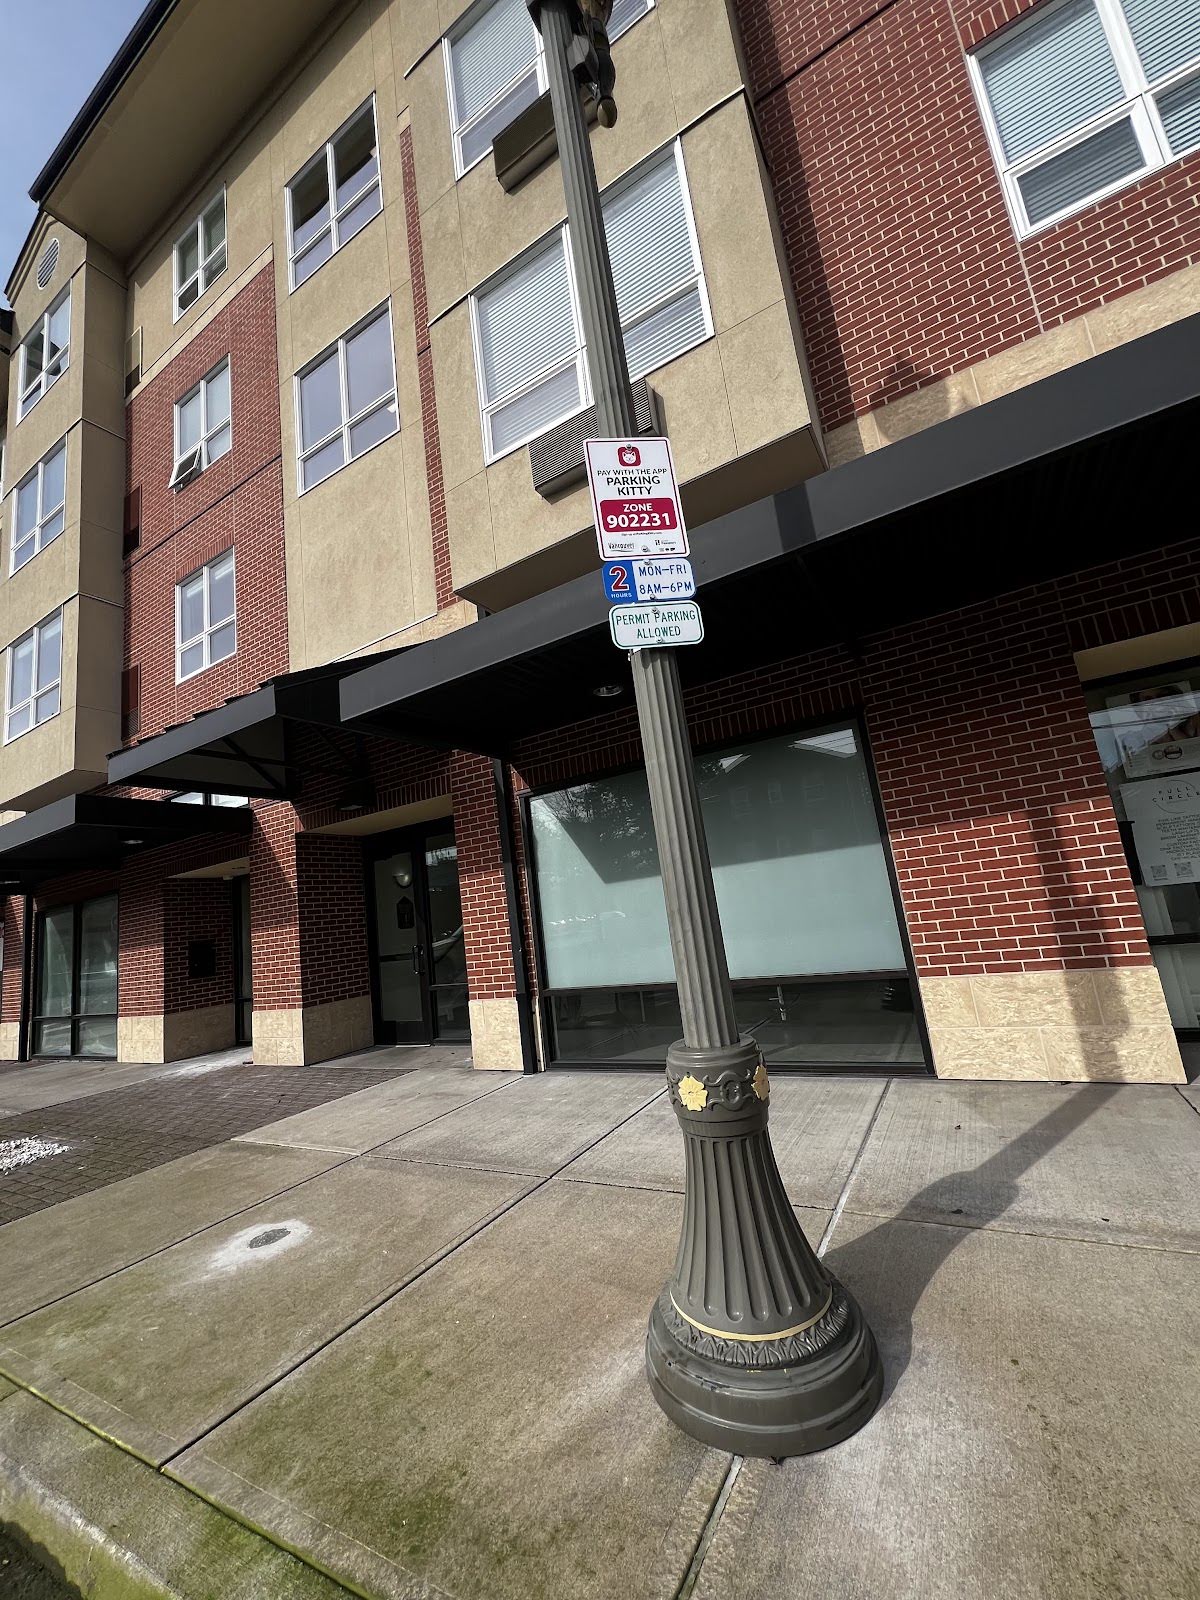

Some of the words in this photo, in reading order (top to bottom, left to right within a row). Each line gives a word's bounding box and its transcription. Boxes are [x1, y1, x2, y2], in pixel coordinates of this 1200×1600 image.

[606, 475, 661, 486] PARKING
[617, 486, 652, 496] KITTY
[623, 503, 653, 512] ZONE
[606, 512, 671, 529] 902231
[638, 564, 687, 577] MON-FRI
[609, 565, 629, 591] 2
[639, 581, 692, 594] 8AM-6PM
[615, 613, 650, 626] PERMIT
[654, 610, 696, 623] PARKING
[637, 626, 681, 639] ALLOWED
